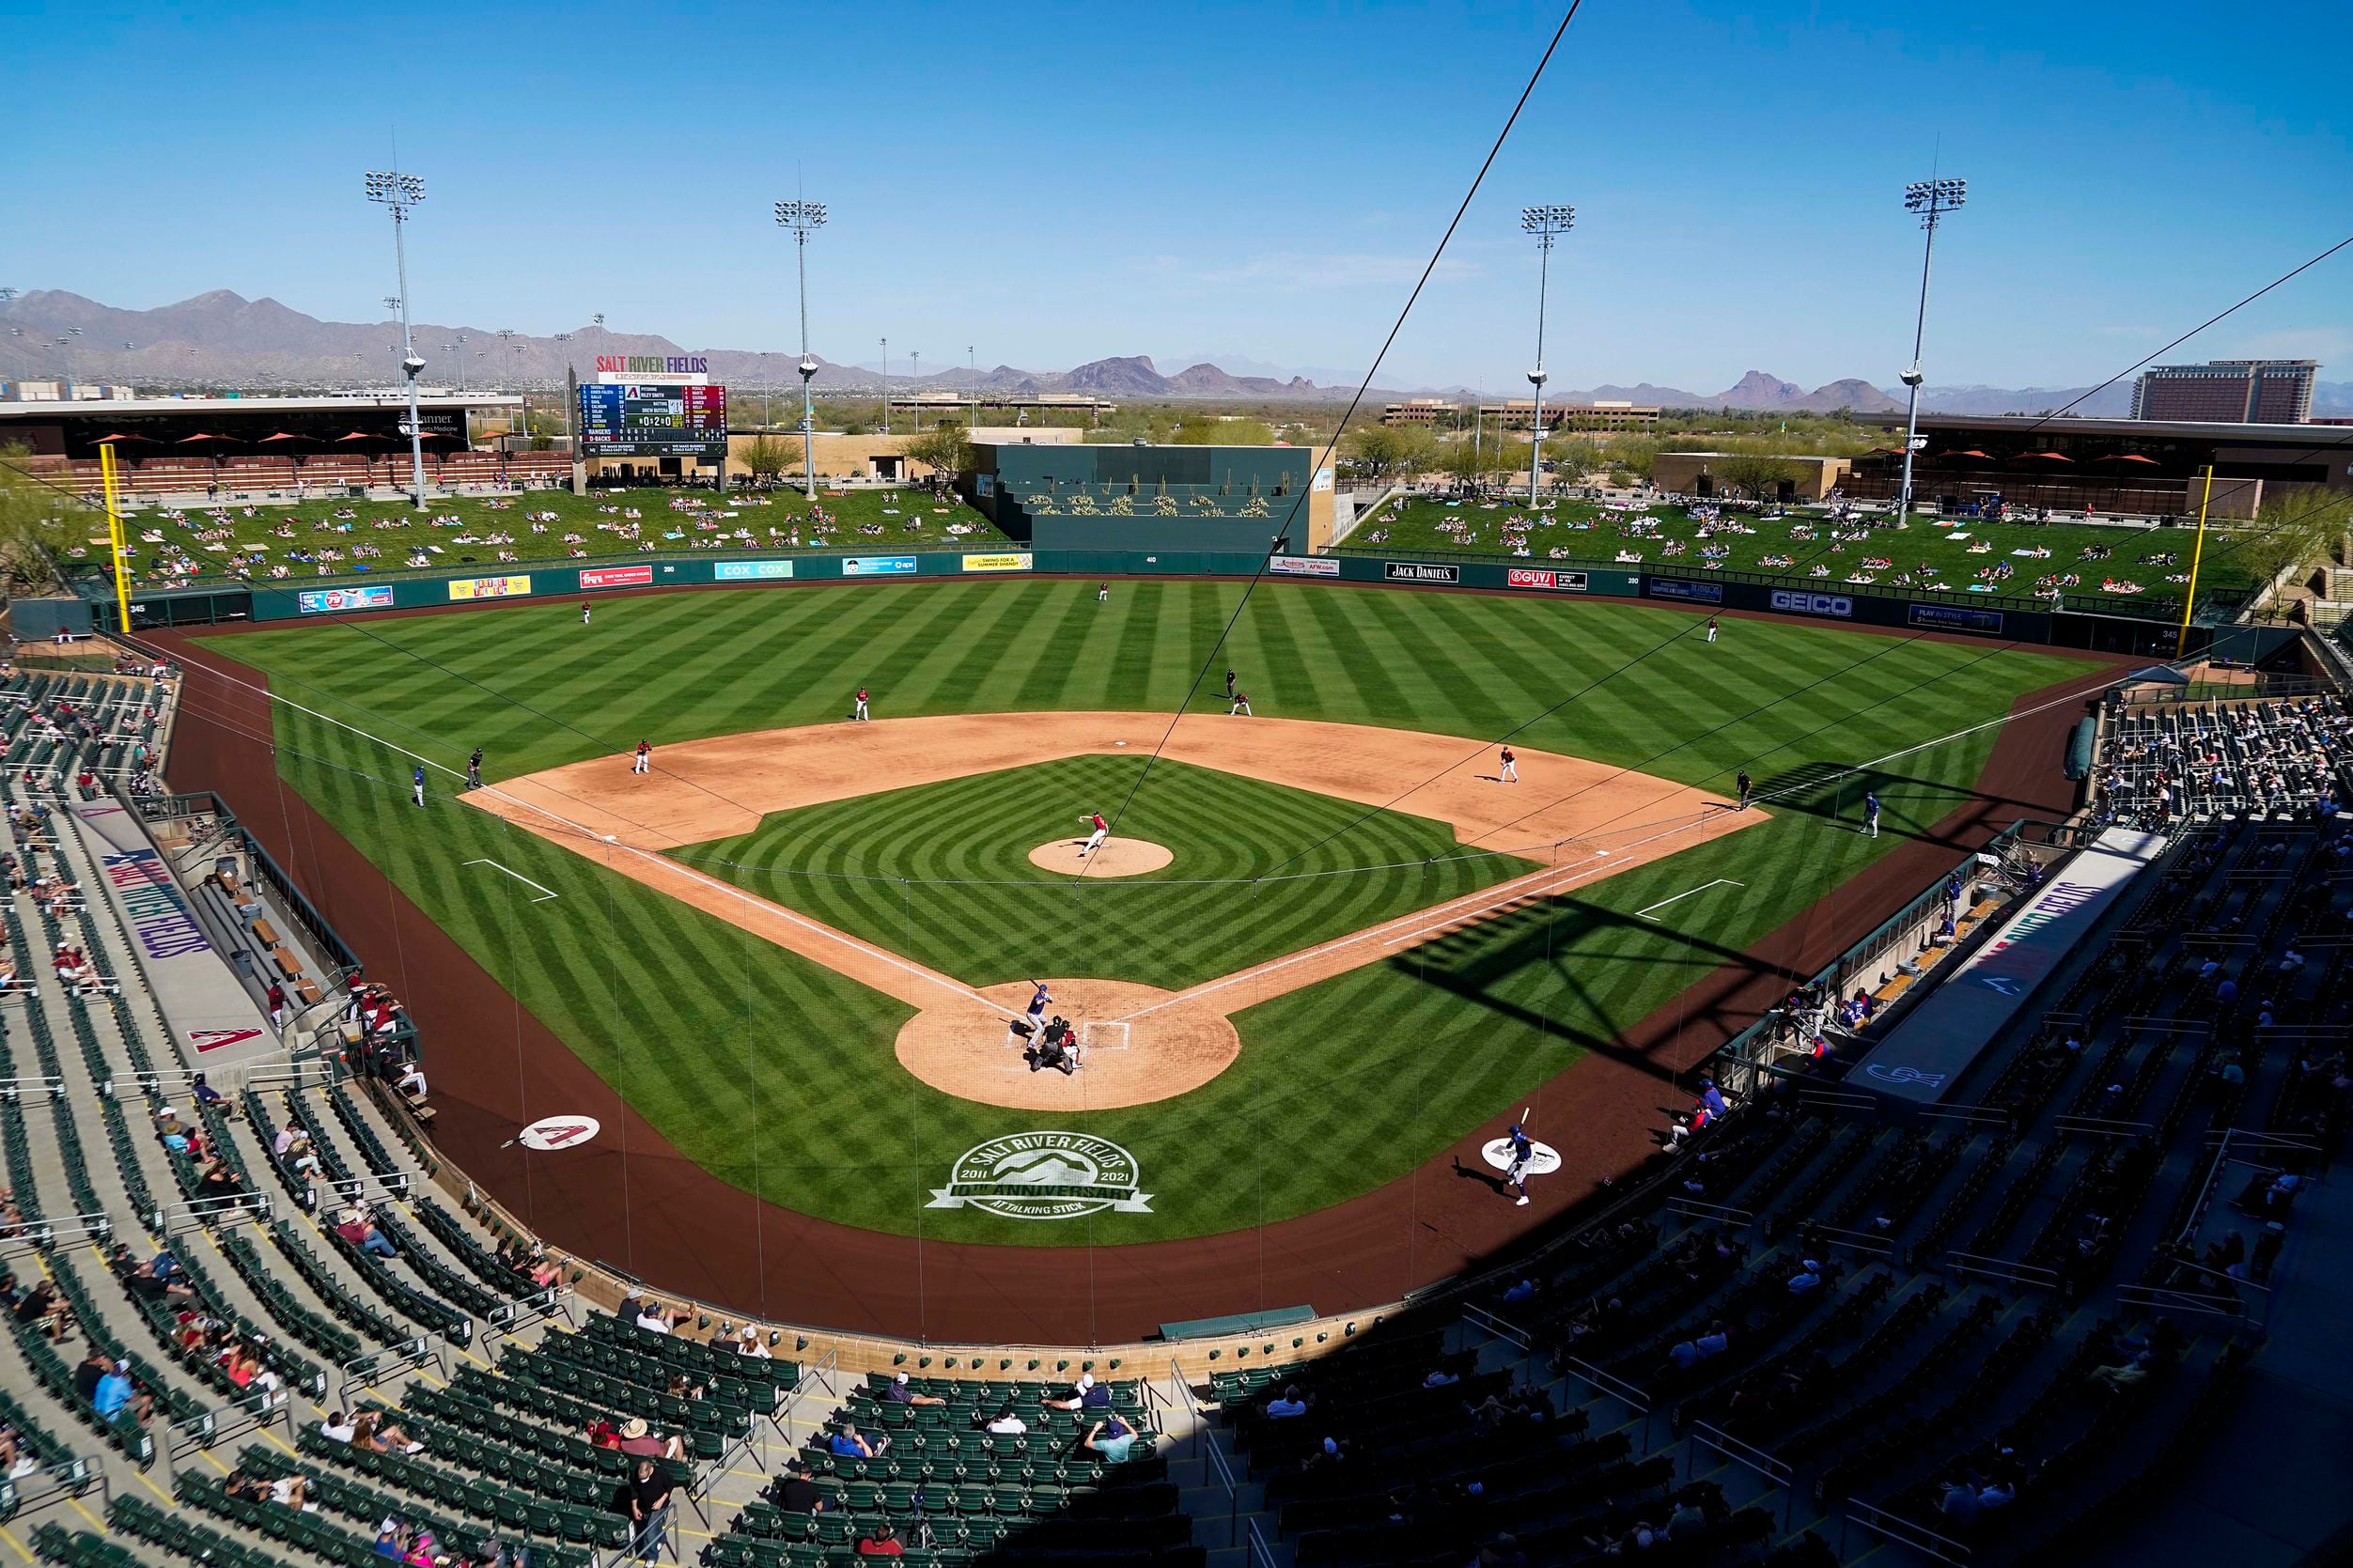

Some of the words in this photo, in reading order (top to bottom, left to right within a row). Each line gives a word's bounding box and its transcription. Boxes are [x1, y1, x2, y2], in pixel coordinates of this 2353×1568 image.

[596, 356, 625, 372] SALT
[628, 356, 664, 373] RIVER
[667, 357, 707, 373] FIELDS
[644, 416, 649, 426] 0
[654, 416, 660, 426] 2
[665, 416, 671, 426] 0
[724, 566, 750, 575] COX
[759, 565, 783, 574] COX
[1392, 564, 1414, 577] JACK
[1522, 572, 1551, 583] GUYS
[130, 605, 145, 613] 345
[1773, 592, 1851, 614] GEICO
[2163, 630, 2177, 638] 345
[107, 862, 170, 887] SALT
[120, 884, 186, 919] RIVER
[135, 914, 212, 959] FIELDS
[970, 1142, 1012, 1166] SALT
[1011, 1135, 1071, 1150] RIVER
[1073, 1137, 1125, 1168] FIELDS
[961, 1170, 987, 1178] 2011
[1101, 1172, 1129, 1181] 2021
[950, 1184, 987, 1196] 10TH
[993, 1185, 1136, 1200] ANNIVERSARY
[990, 1199, 1006, 1209] AT
[1005, 1203, 1050, 1214] TALKING
[1052, 1202, 1086, 1213] STICK
